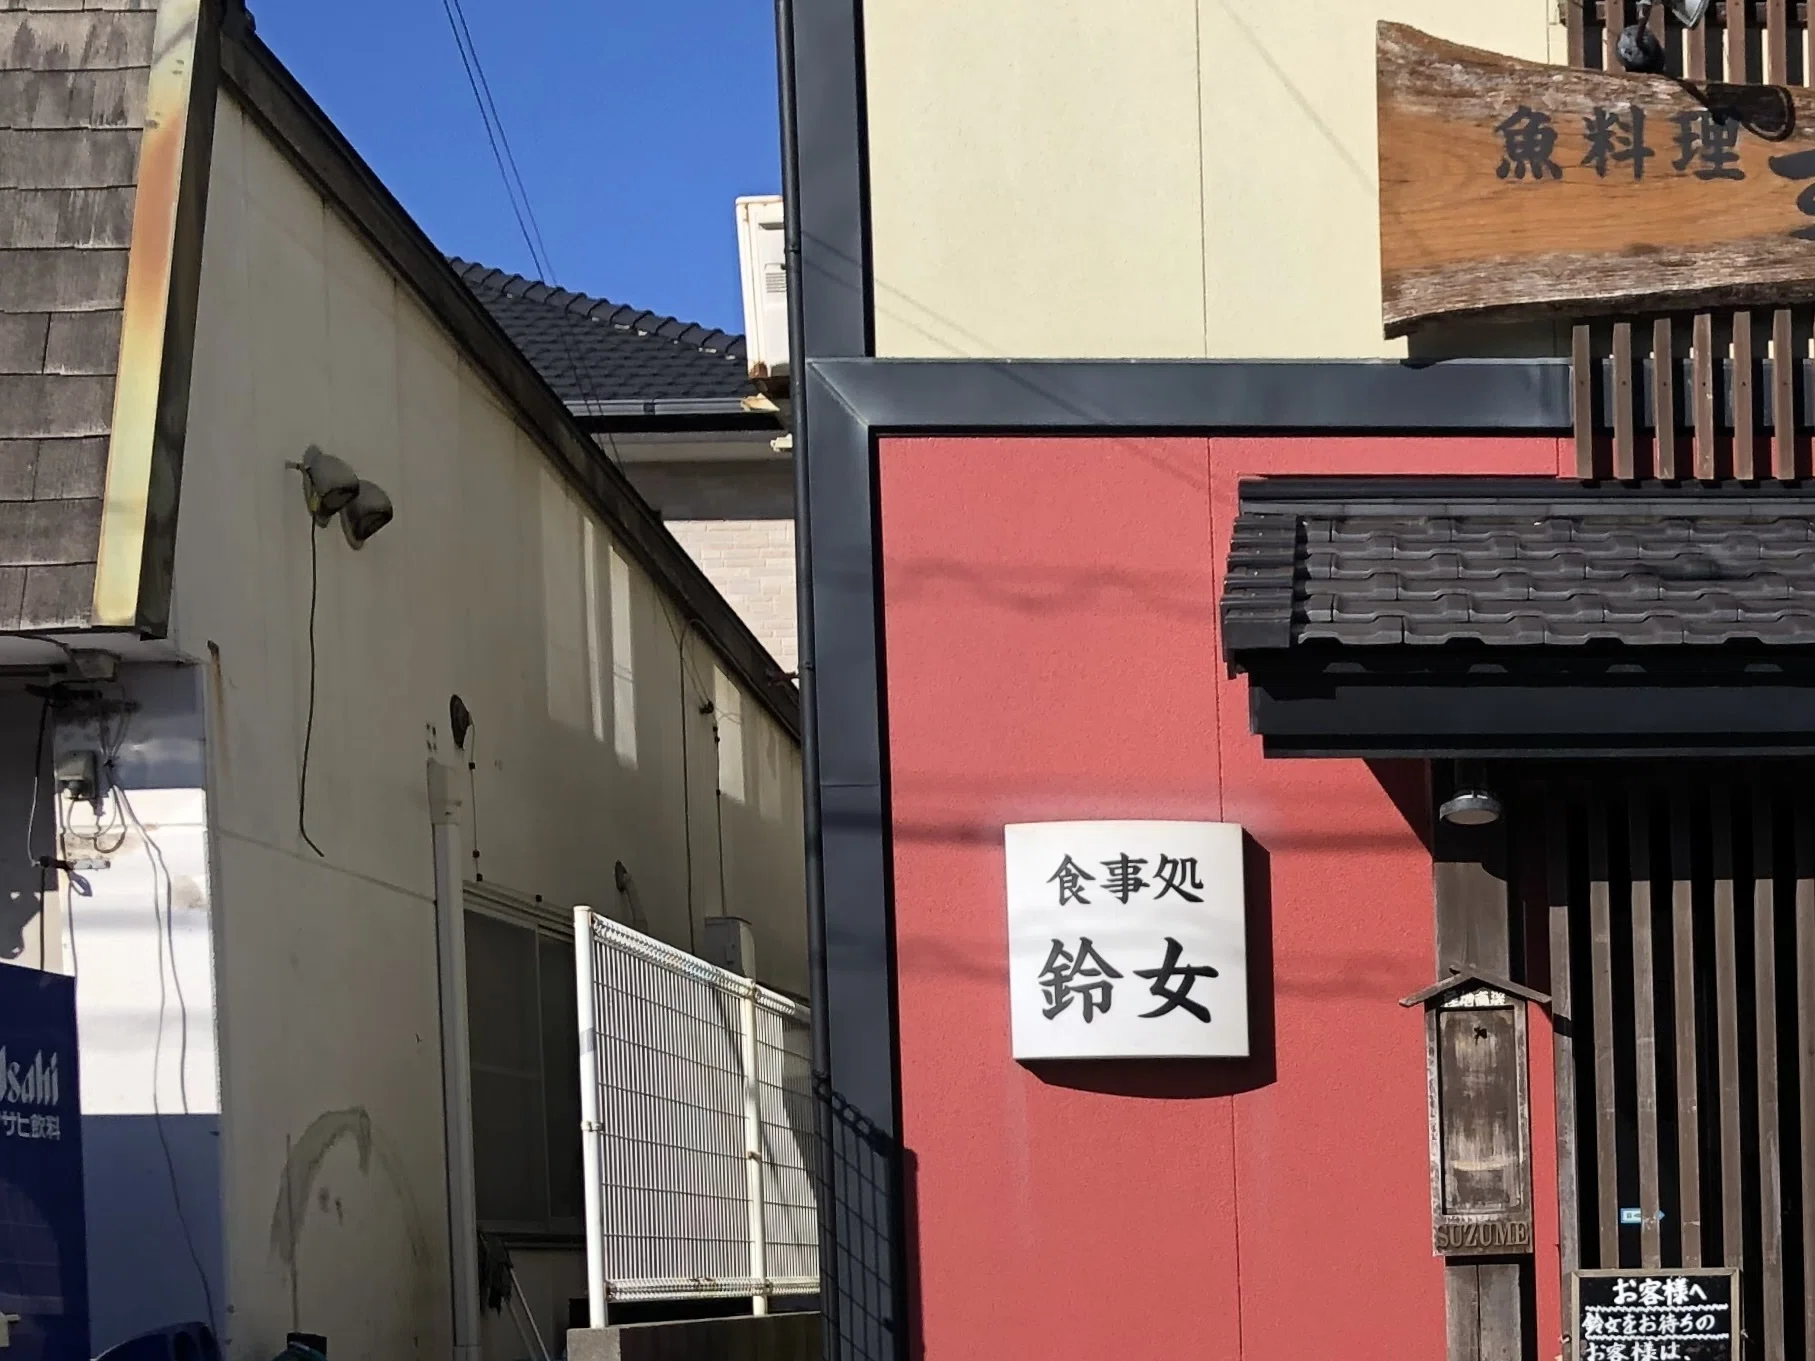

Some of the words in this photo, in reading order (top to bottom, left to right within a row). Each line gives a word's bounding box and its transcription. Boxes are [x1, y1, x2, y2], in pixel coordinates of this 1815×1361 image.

[1494, 104, 1746, 181] 魚料理
[1046, 852, 1204, 906] 食事処
[1037, 936, 1219, 1024] 鈴女
[1437, 1220, 1530, 1250] SUZUME
[1612, 1278, 1707, 1306] お客様へ
[1582, 1312, 1715, 1335] 鈴女をお待ちの
